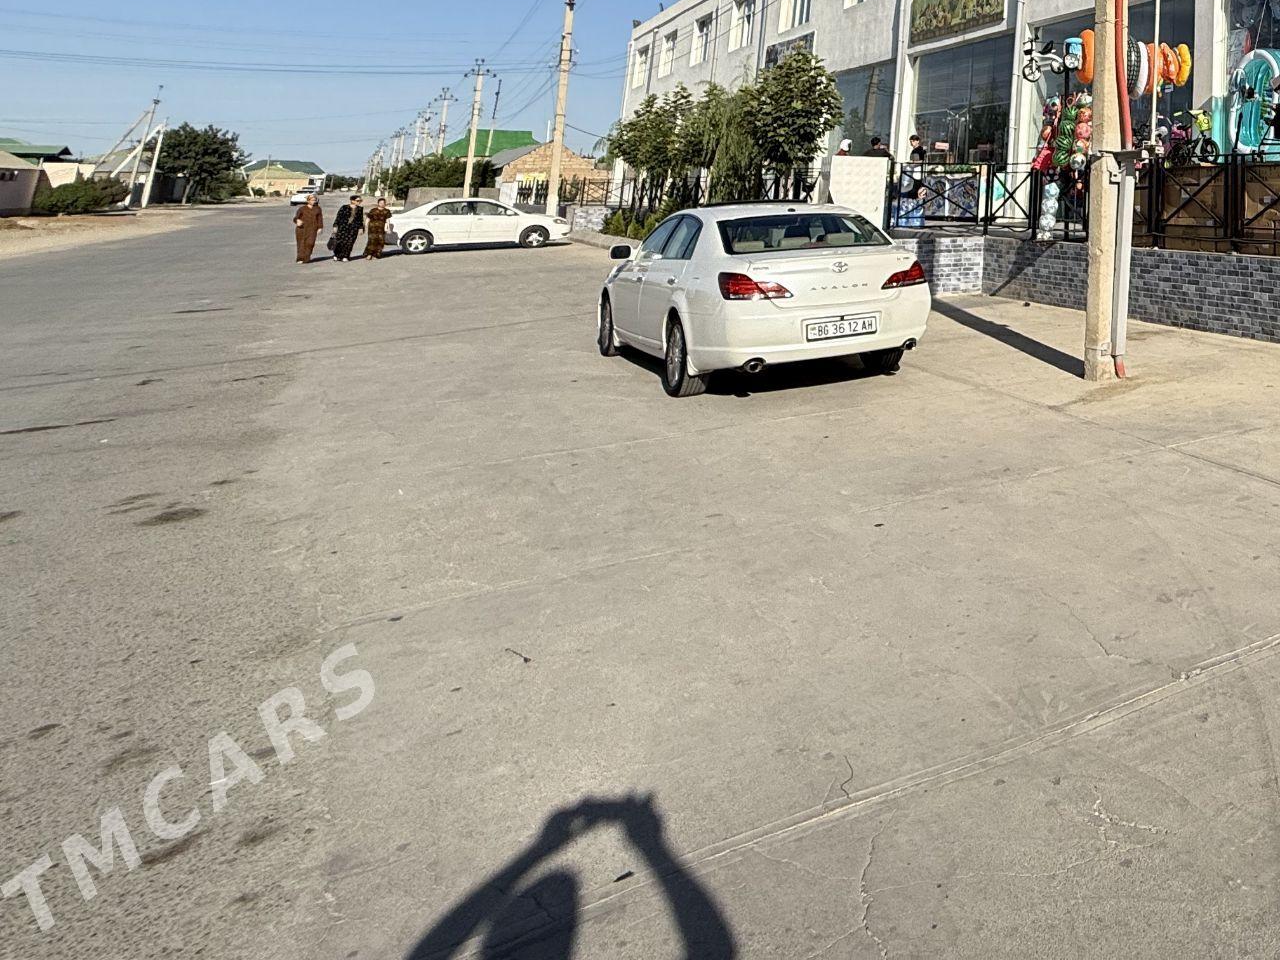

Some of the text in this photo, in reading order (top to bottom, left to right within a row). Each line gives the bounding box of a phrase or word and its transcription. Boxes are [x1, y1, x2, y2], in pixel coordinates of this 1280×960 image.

[809, 283, 868, 291] AVALON
[817, 320, 873, 337] BG 36 12 AH
